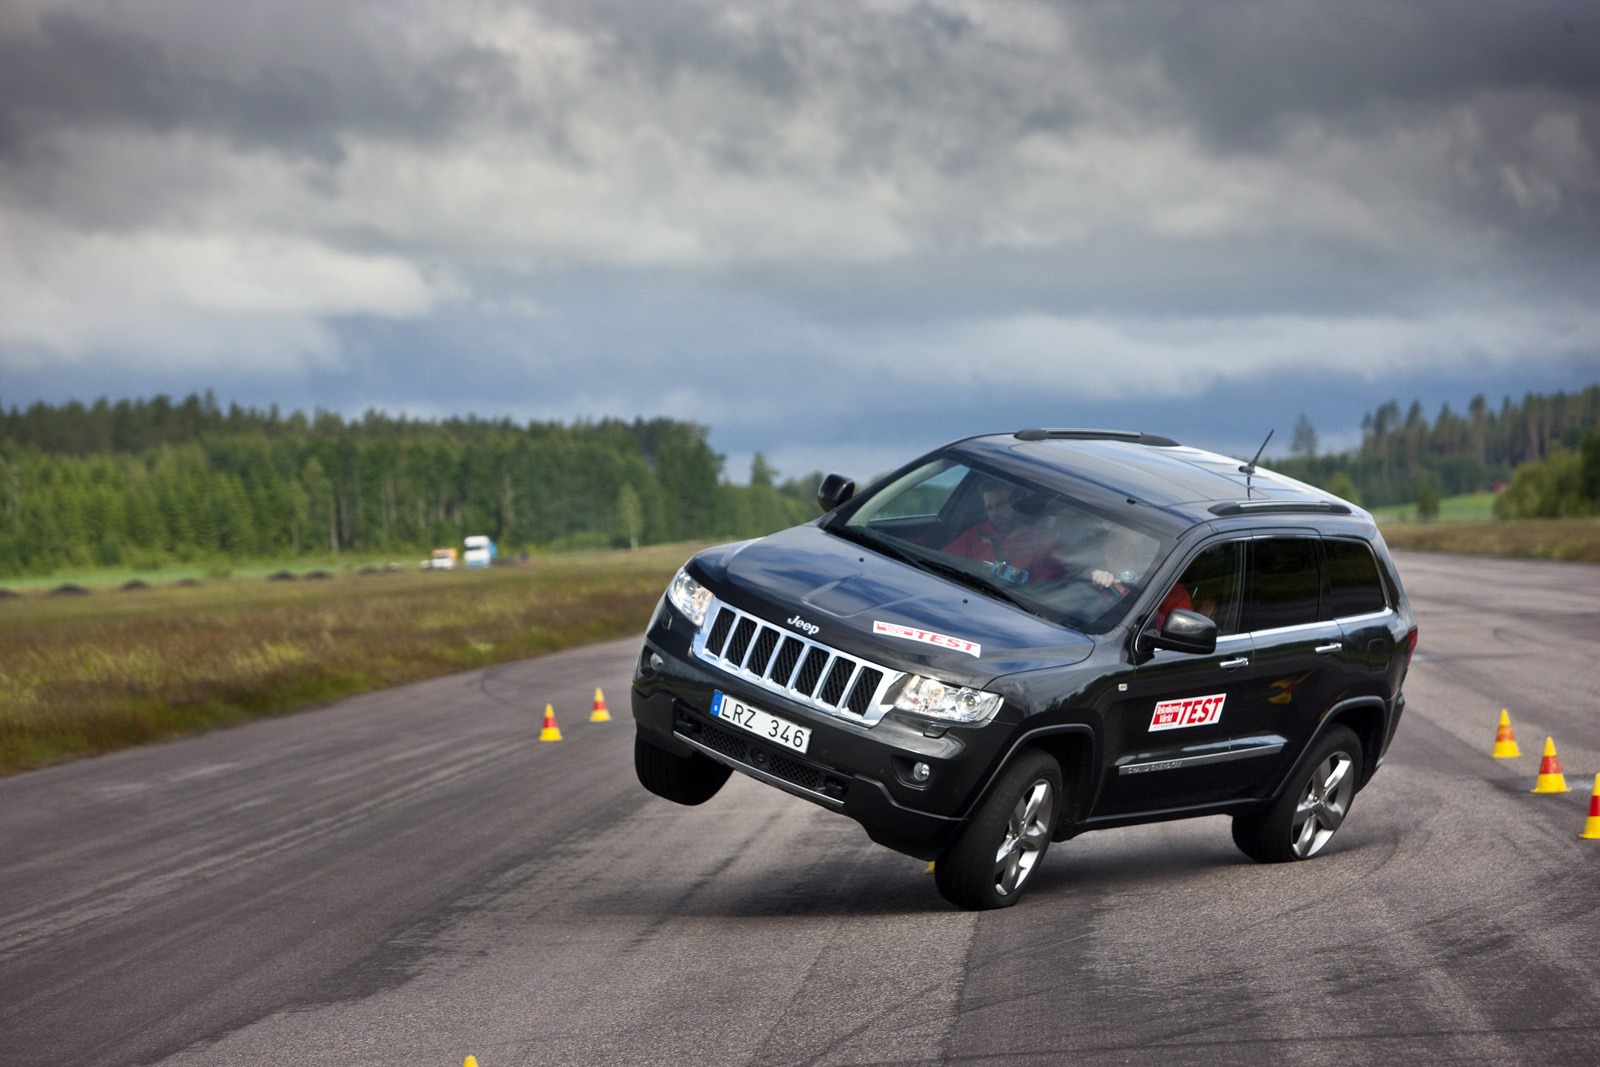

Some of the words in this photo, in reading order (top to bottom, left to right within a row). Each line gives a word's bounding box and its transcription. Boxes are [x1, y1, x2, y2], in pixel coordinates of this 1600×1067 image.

[787, 615, 820, 636] Jeep
[915, 630, 977, 651] TEST
[721, 697, 757, 729] LRZ
[768, 719, 805, 748] 346
[1179, 697, 1224, 725] TEST
